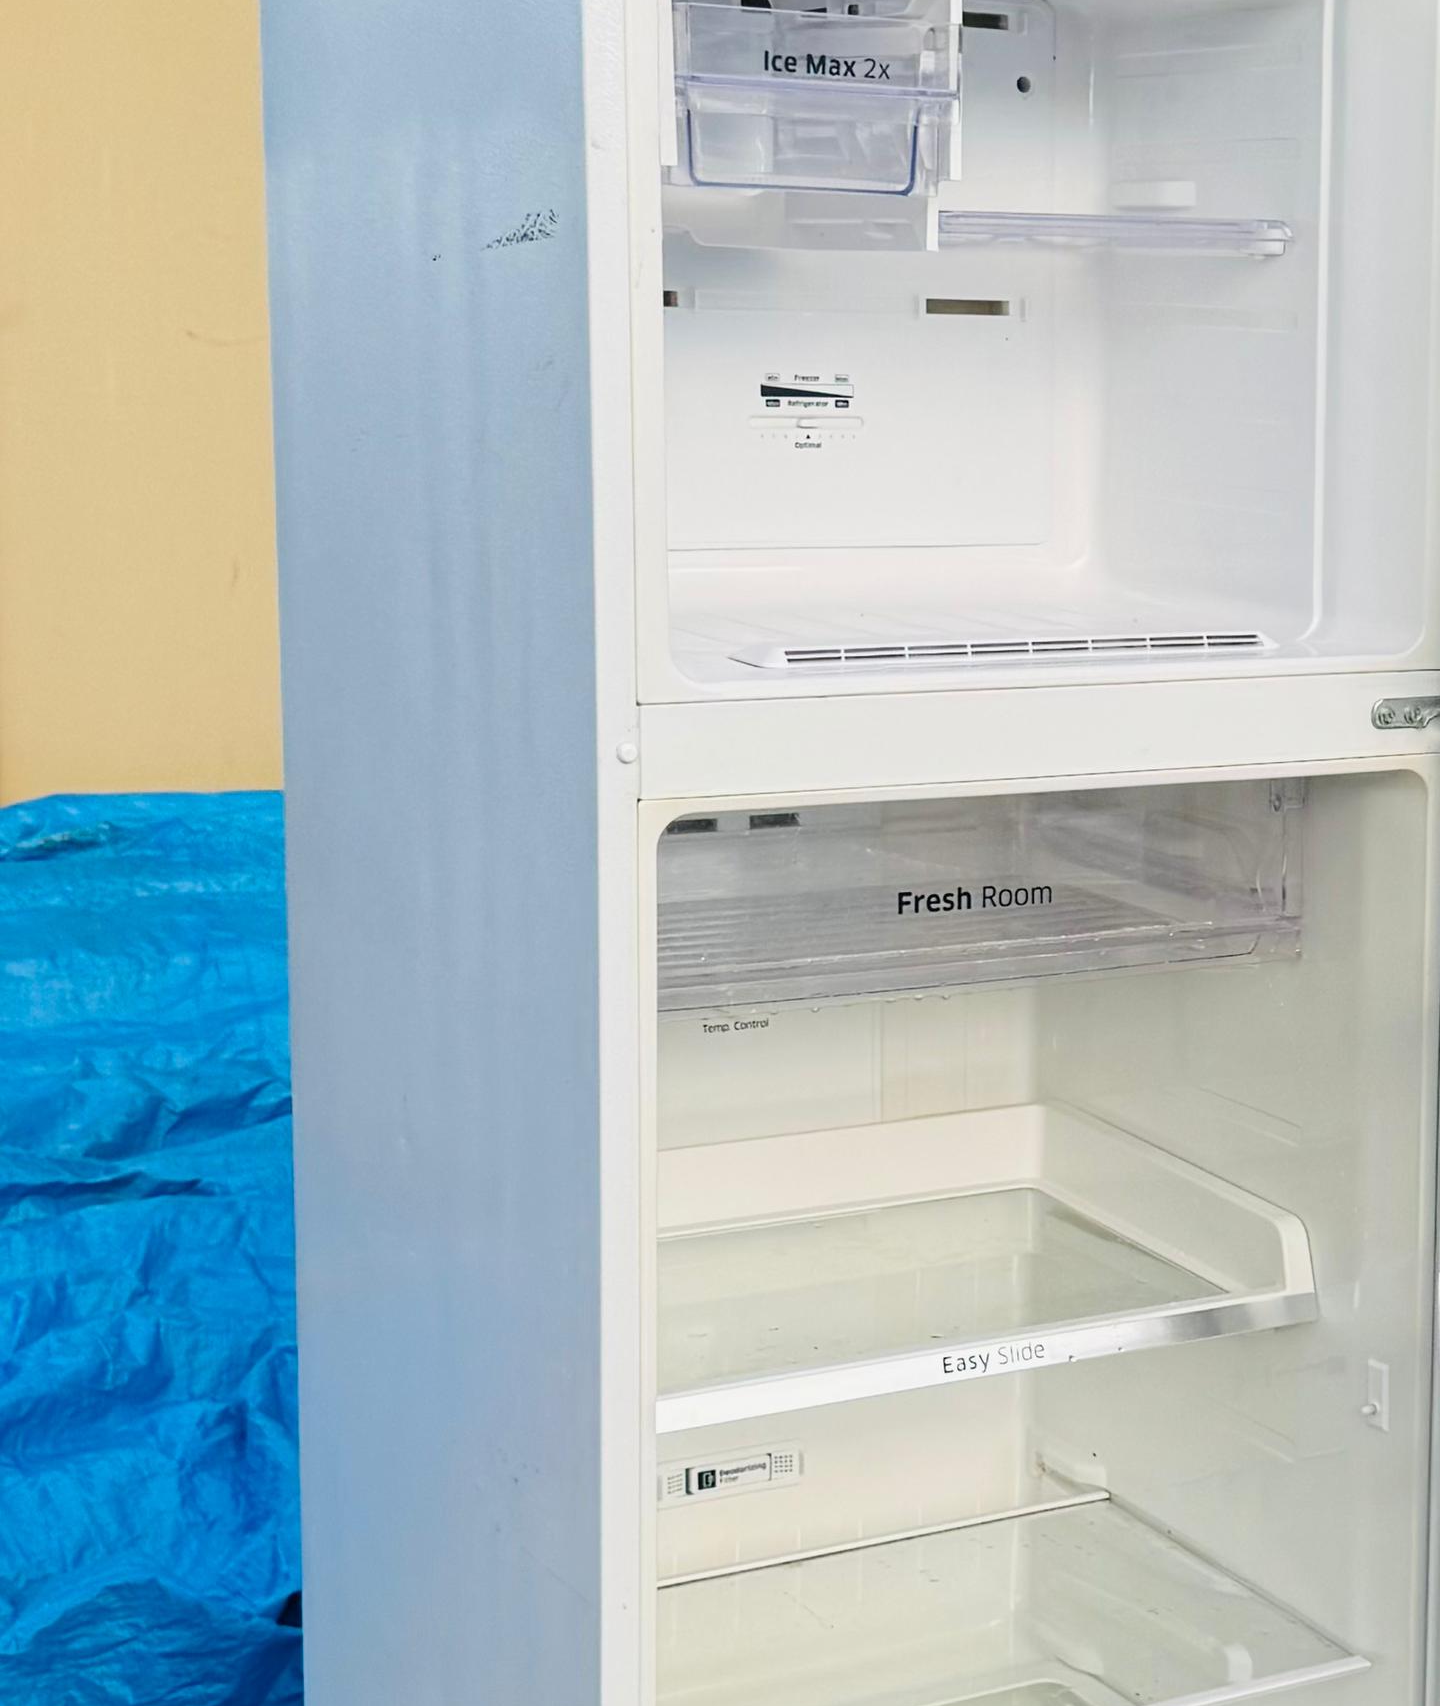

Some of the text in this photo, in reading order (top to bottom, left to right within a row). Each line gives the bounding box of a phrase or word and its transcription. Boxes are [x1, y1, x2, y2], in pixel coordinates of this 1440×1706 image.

[764, 50, 890, 80] Ice Max 2x
[897, 885, 1052, 915] Fresh Room
[733, 1017, 769, 1031] Control
[942, 1341, 1045, 1374] Easy Slide
